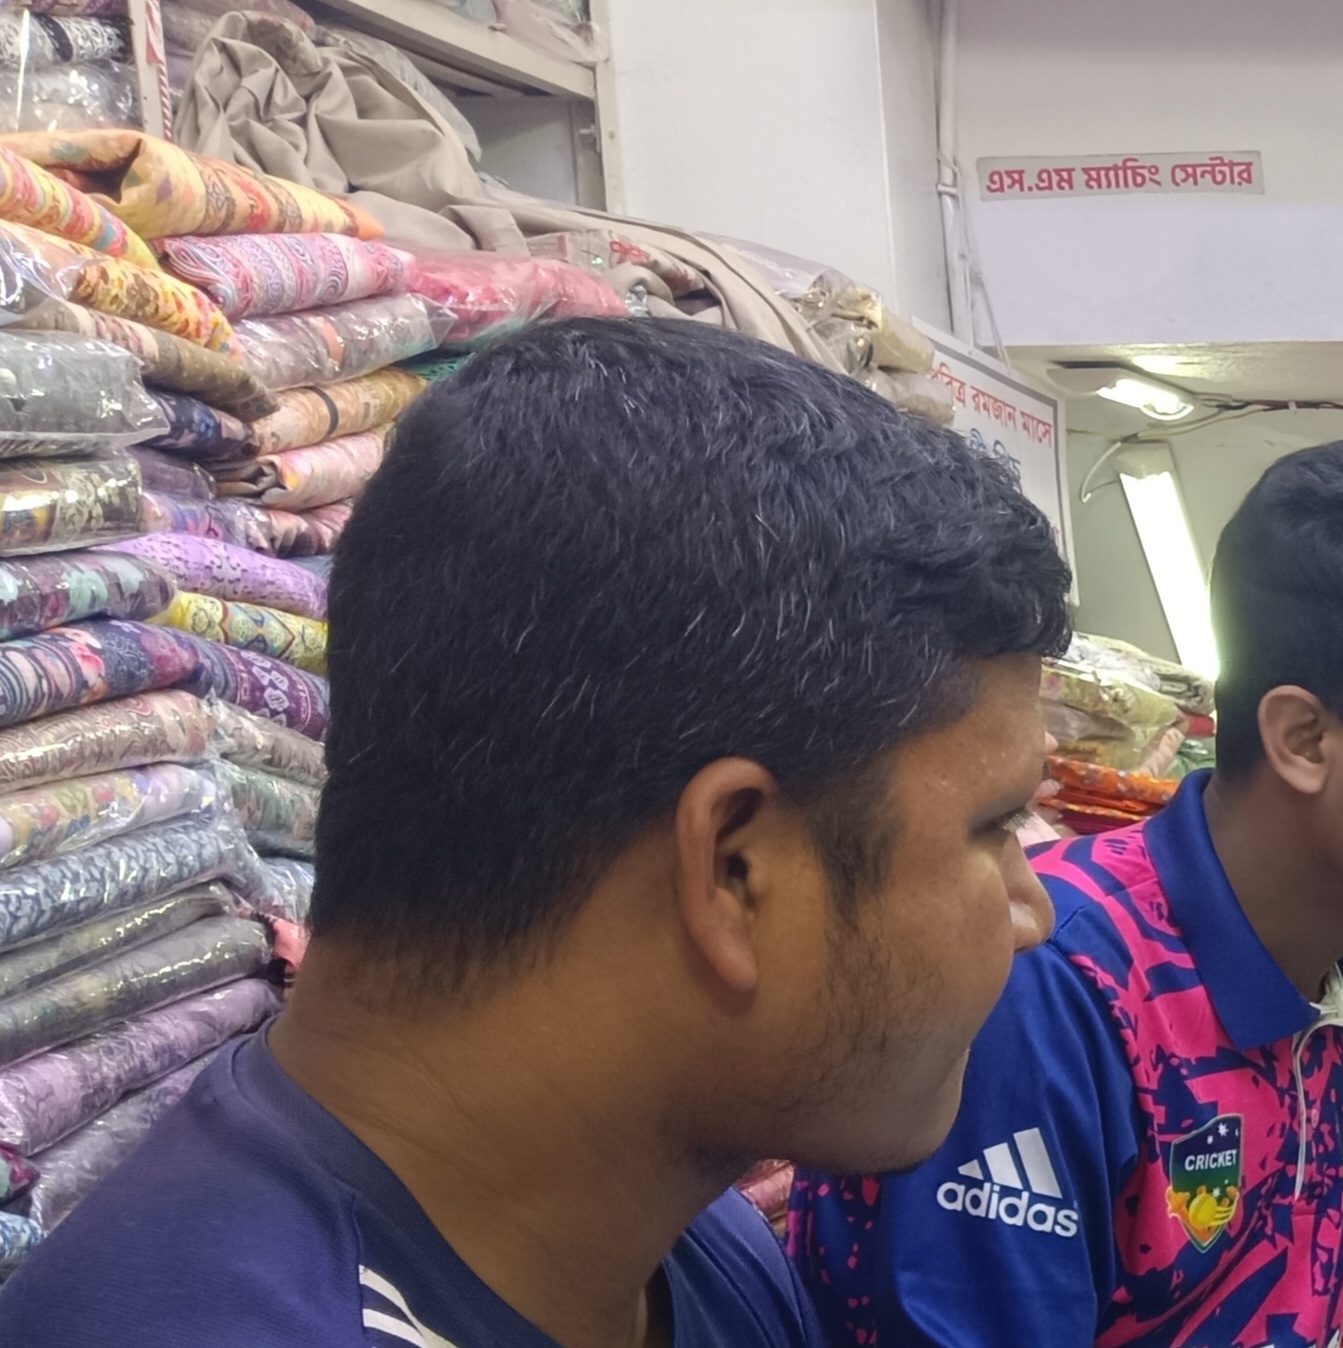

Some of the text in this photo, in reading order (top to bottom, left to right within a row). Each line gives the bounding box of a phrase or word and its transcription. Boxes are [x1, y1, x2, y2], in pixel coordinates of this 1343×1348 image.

[986, 156, 1253, 193] এস.এম ম্যাচিং সেন্টার
[1184, 1148, 1238, 1171] CRICKET
[937, 1180, 1079, 1237] adidas
